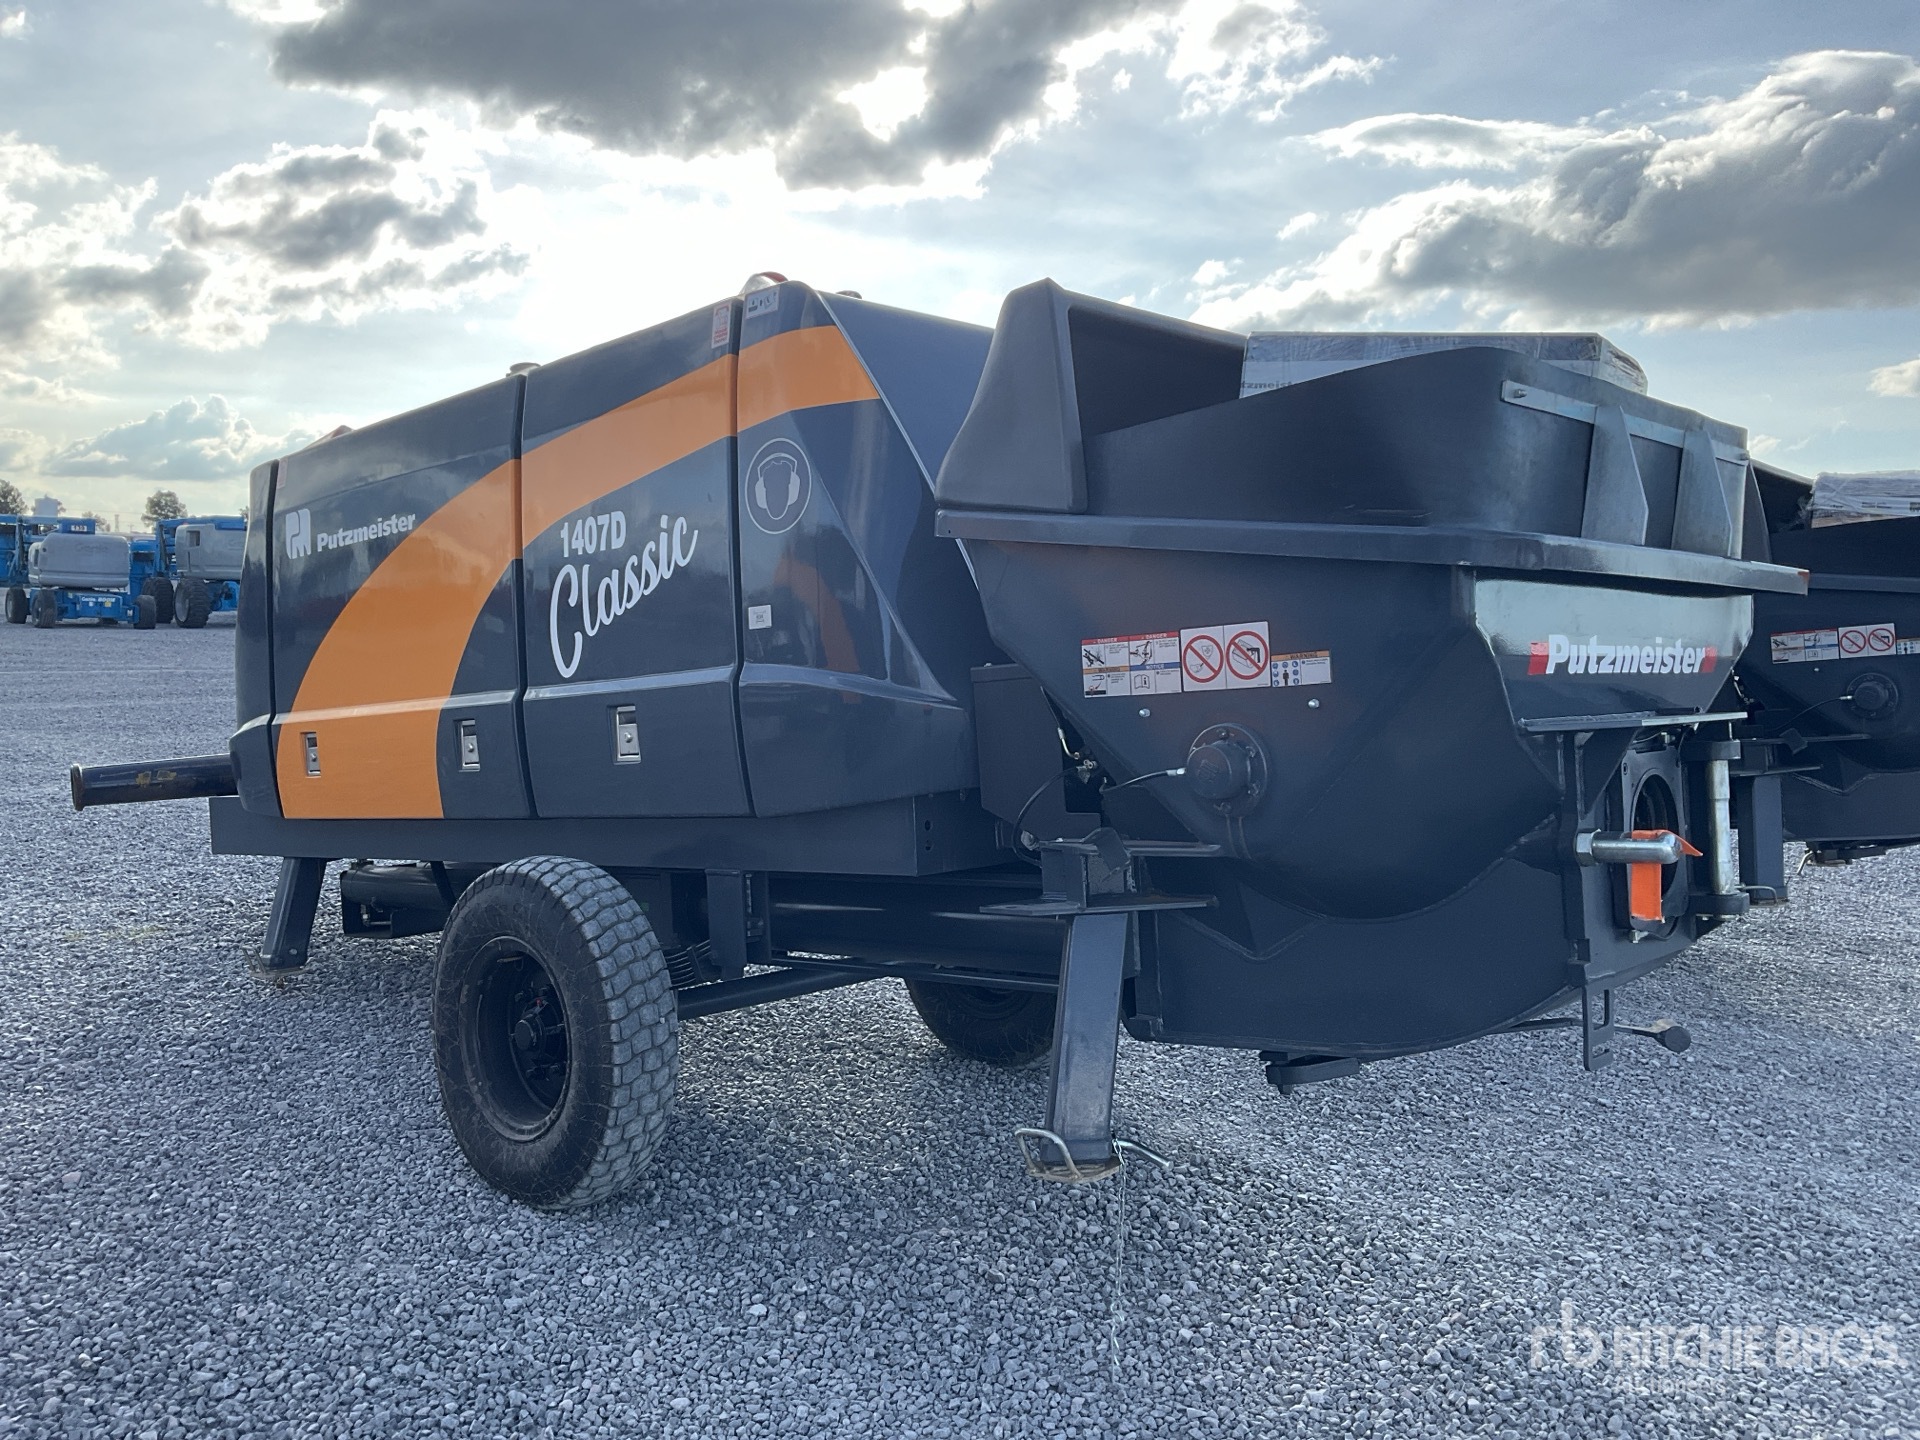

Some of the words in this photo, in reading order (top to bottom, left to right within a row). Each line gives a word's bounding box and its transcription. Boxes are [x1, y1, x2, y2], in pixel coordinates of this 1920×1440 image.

[316, 512, 416, 553] Putzmeister
[560, 511, 627, 558] 1407D
[550, 514, 698, 678] Classic
[1546, 635, 1706, 675] Putzmeister
